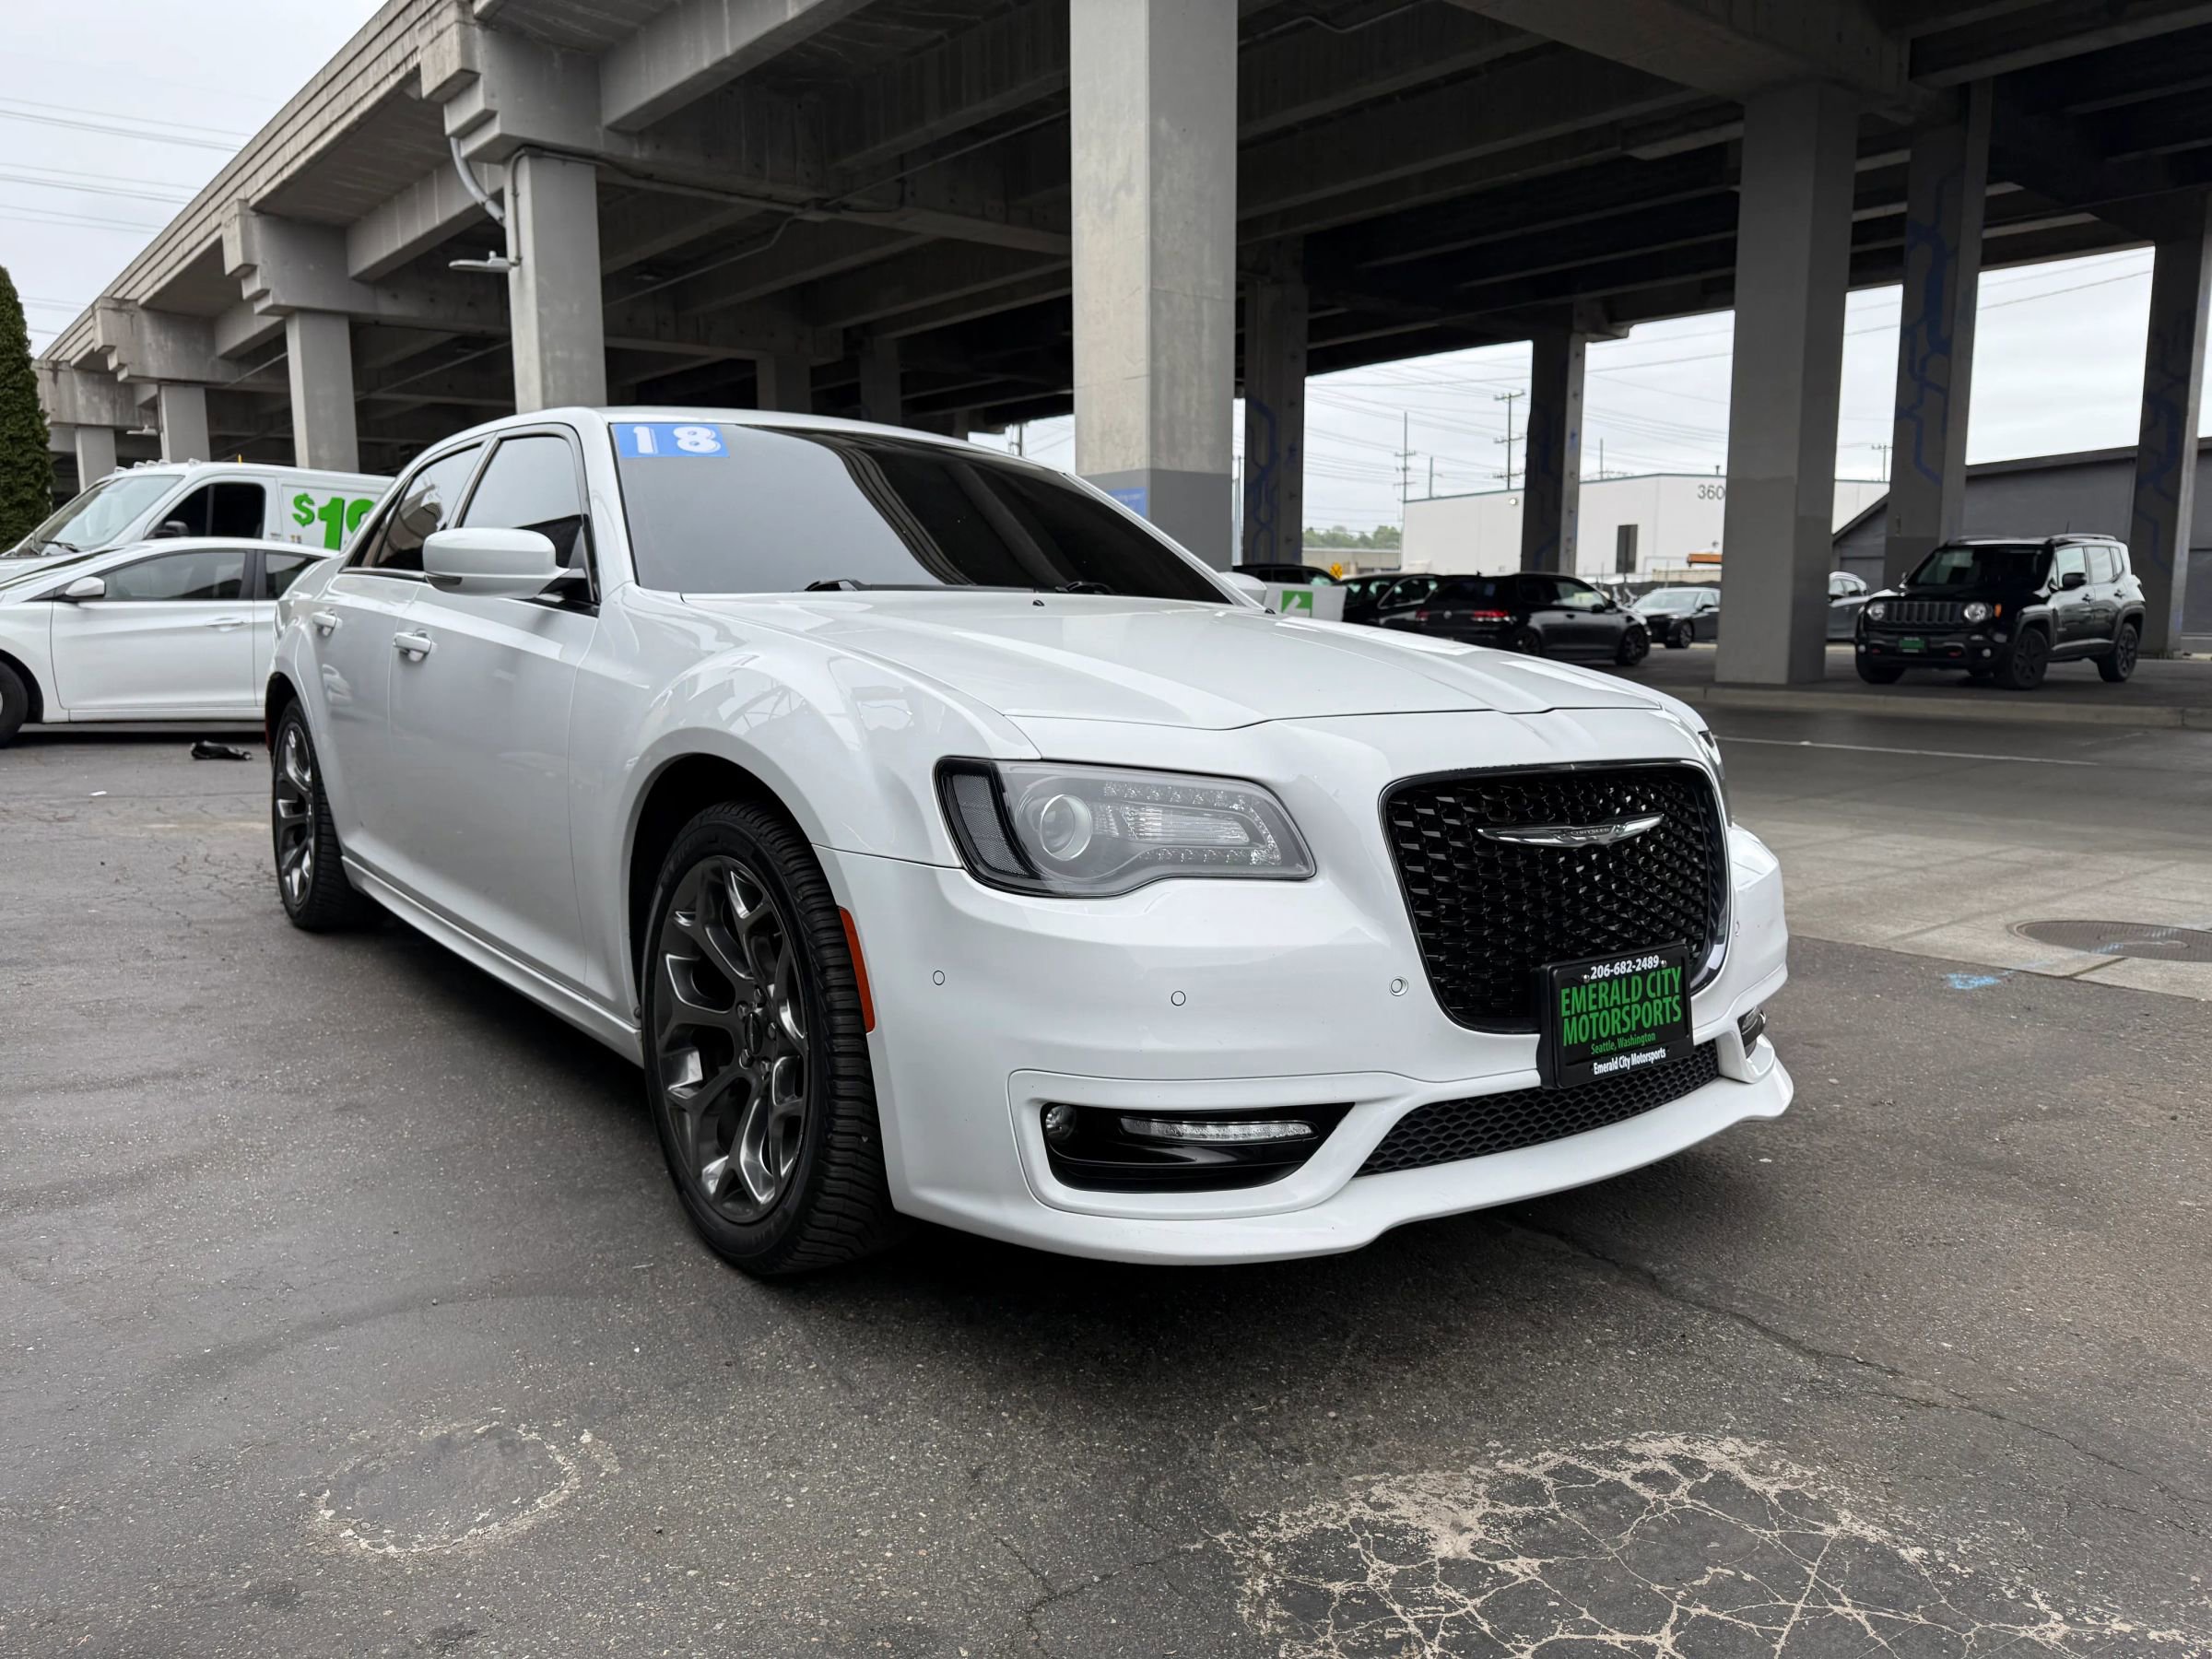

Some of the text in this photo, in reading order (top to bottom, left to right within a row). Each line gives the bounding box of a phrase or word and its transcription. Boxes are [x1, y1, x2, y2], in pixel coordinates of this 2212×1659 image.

[1697, 484, 1725, 500] 360
[1590, 955, 1660, 980] 206-682-2489
[1560, 966, 1682, 1017] EMERALD CITY
[1563, 995, 1682, 1046] MOTORSPORTS
[1591, 1031, 1656, 1054] Seattle, Washington
[1593, 1047, 1666, 1075] Emerald City Motorsports
